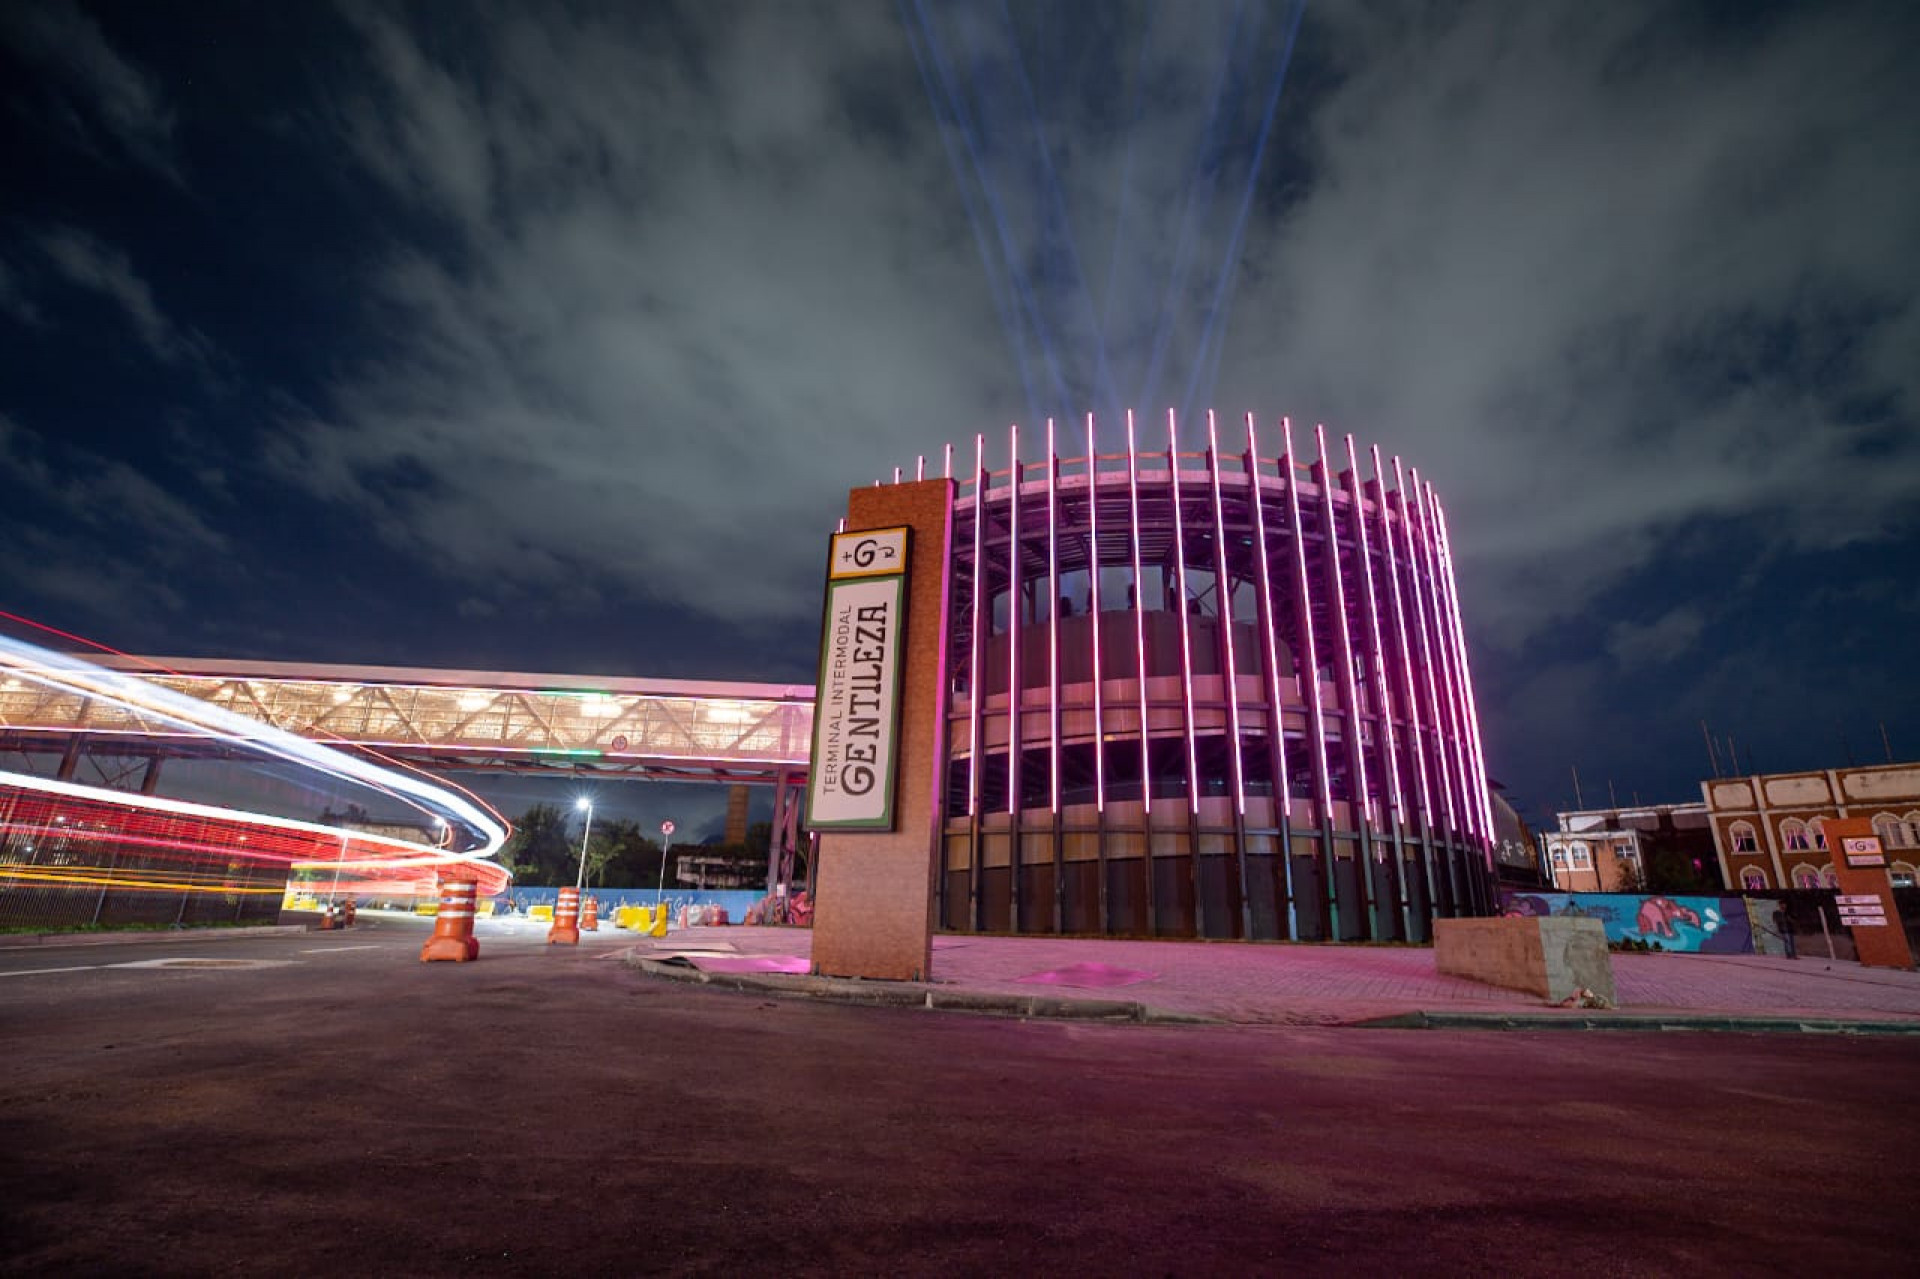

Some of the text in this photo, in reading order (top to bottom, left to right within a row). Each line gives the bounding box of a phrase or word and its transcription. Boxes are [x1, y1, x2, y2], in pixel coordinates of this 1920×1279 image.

[823, 604, 851, 795] TERMINAL INTERMODAL
[841, 602, 887, 796] GENTILEZA
